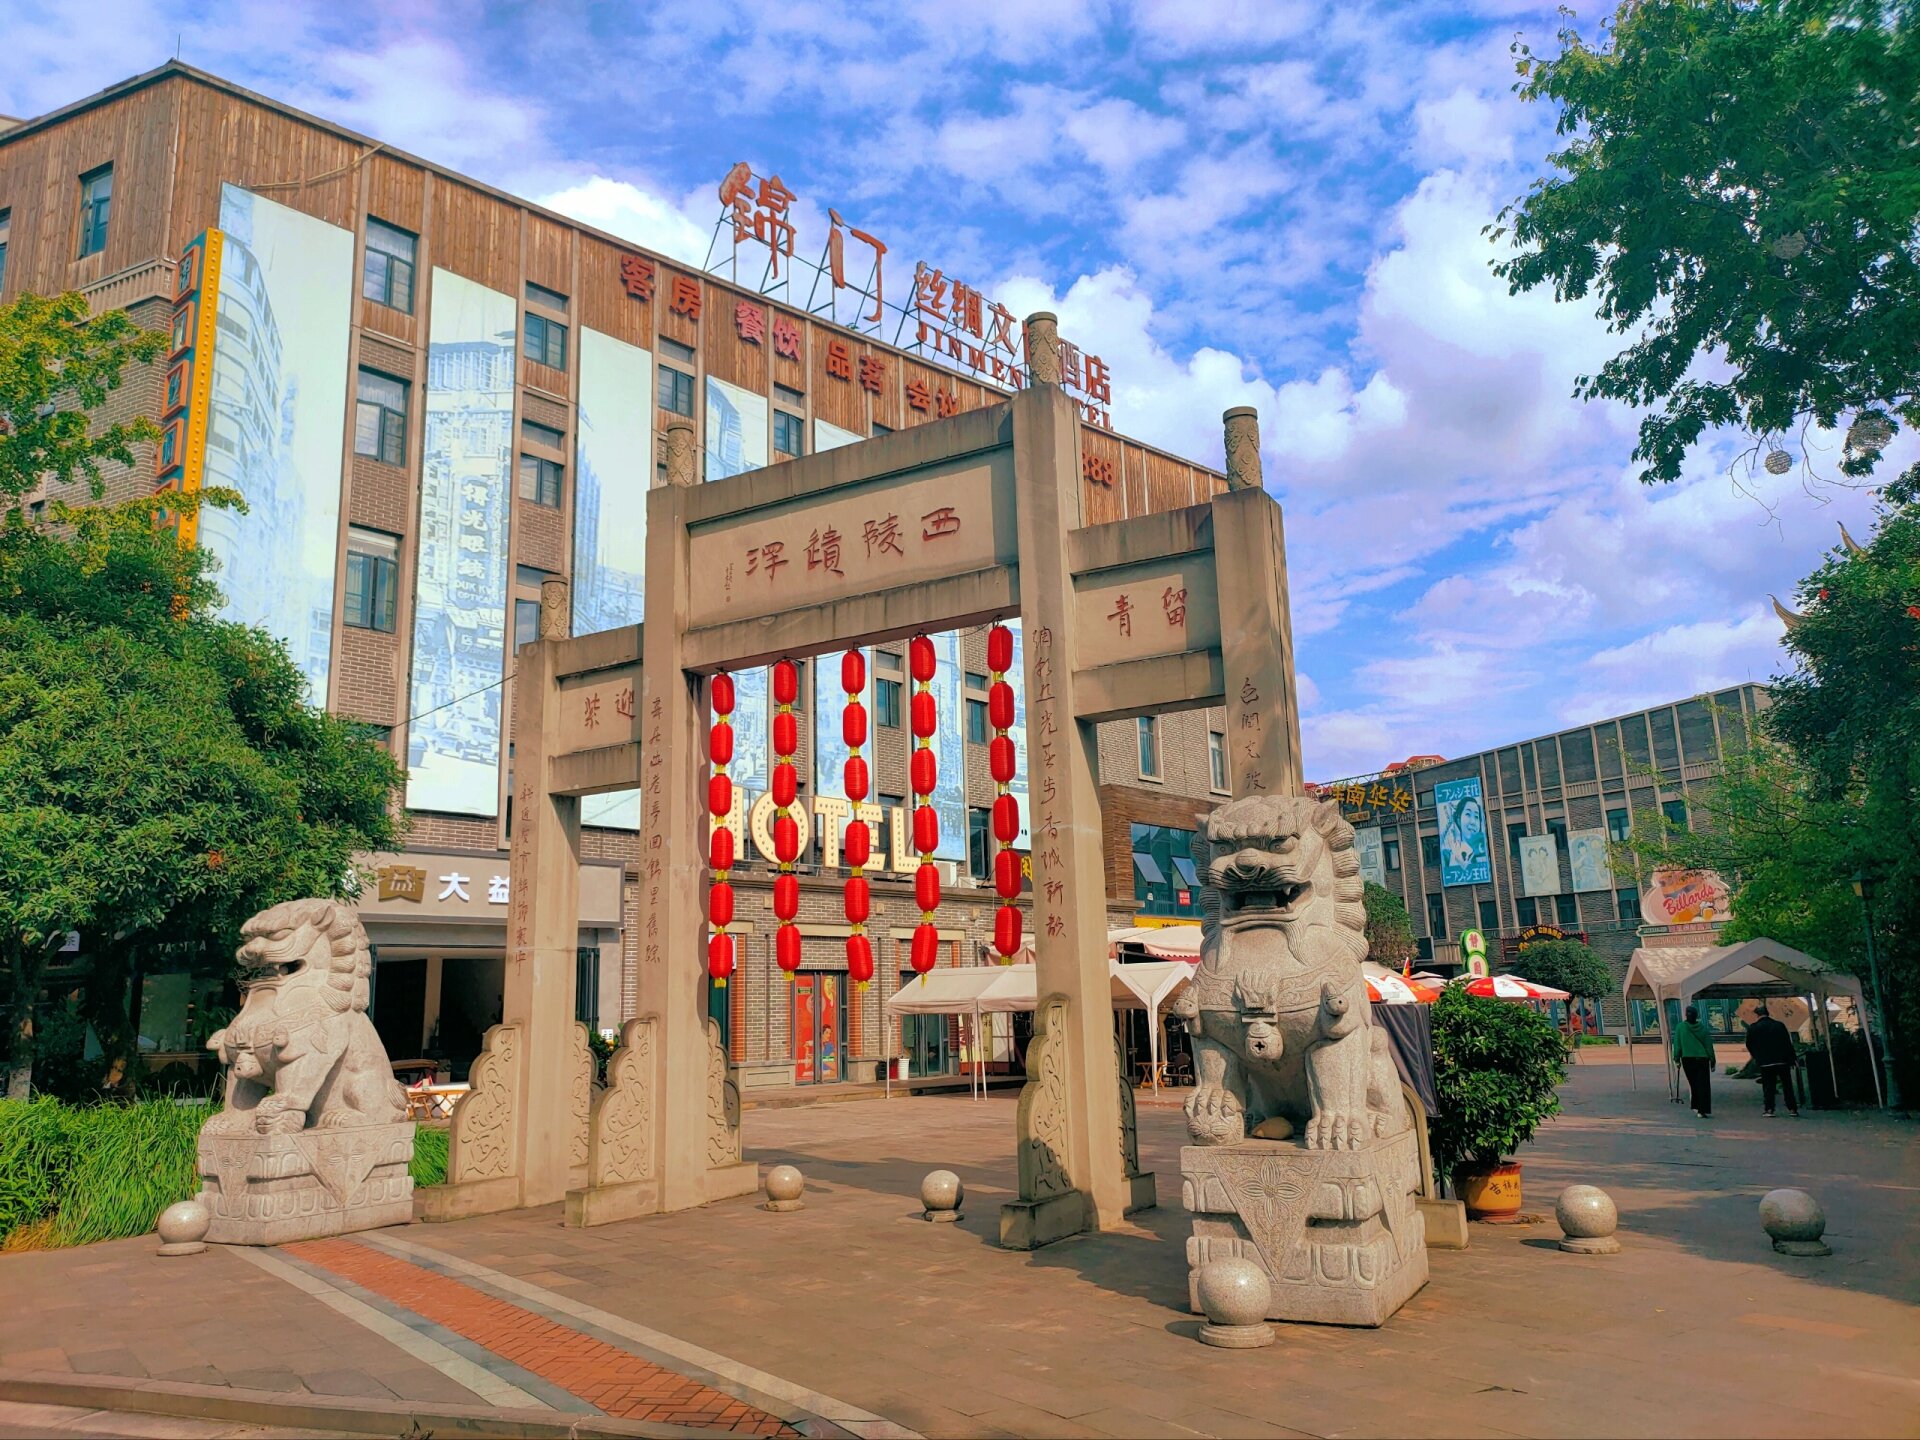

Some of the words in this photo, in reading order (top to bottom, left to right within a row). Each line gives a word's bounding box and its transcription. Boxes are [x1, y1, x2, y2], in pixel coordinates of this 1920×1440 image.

[621, 254, 702, 321] 客房
[735, 300, 801, 361] 餐饮
[827, 340, 885, 395] 品茗
[914, 260, 1111, 405] 丝绸文酒店
